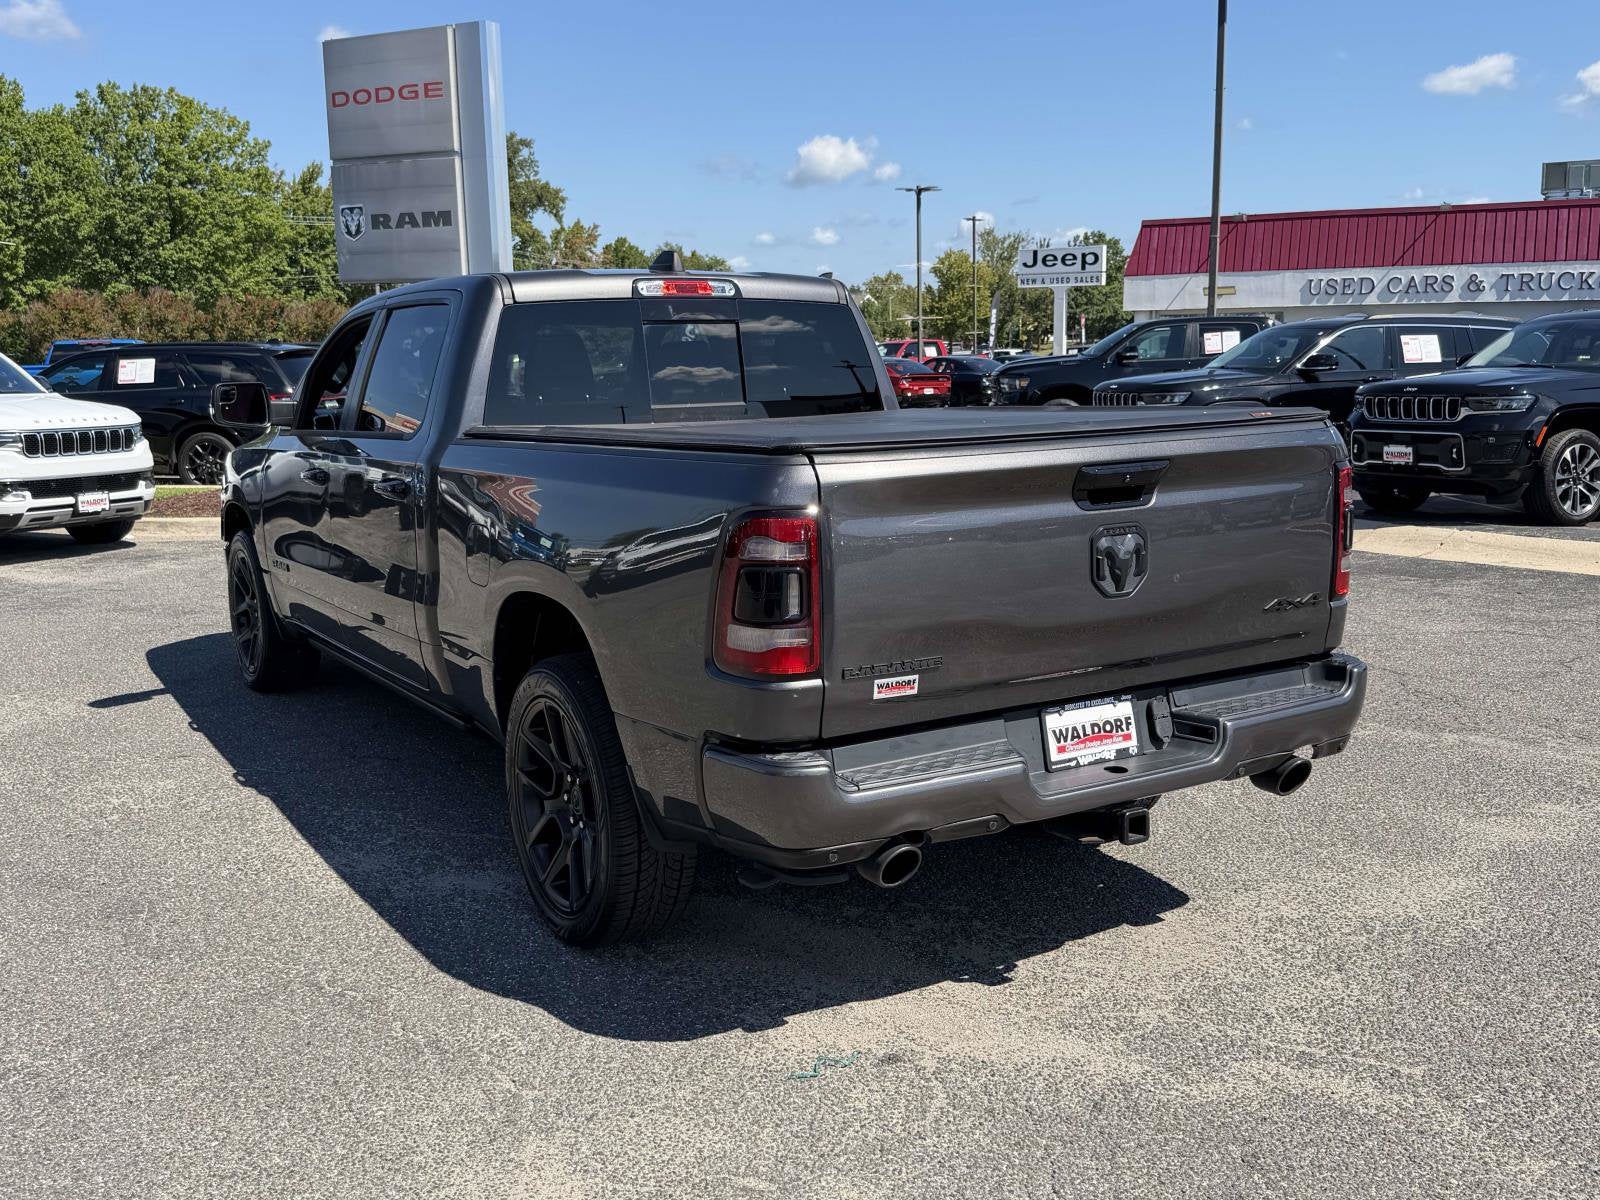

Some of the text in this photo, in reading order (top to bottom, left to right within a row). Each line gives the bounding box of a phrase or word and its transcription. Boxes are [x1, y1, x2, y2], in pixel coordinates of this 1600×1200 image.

[331, 81, 444, 108] DODGE
[370, 209, 453, 230] RAM
[1022, 249, 1099, 271] Jeep
[1020, 278, 1037, 286] NEW
[1050, 276, 1071, 284] USED
[1074, 275, 1100, 284] SALES
[1308, 271, 1600, 296] USED CARS & TRUCK
[876, 679, 917, 691] WALDORF
[1051, 716, 1132, 744] WALDORF
